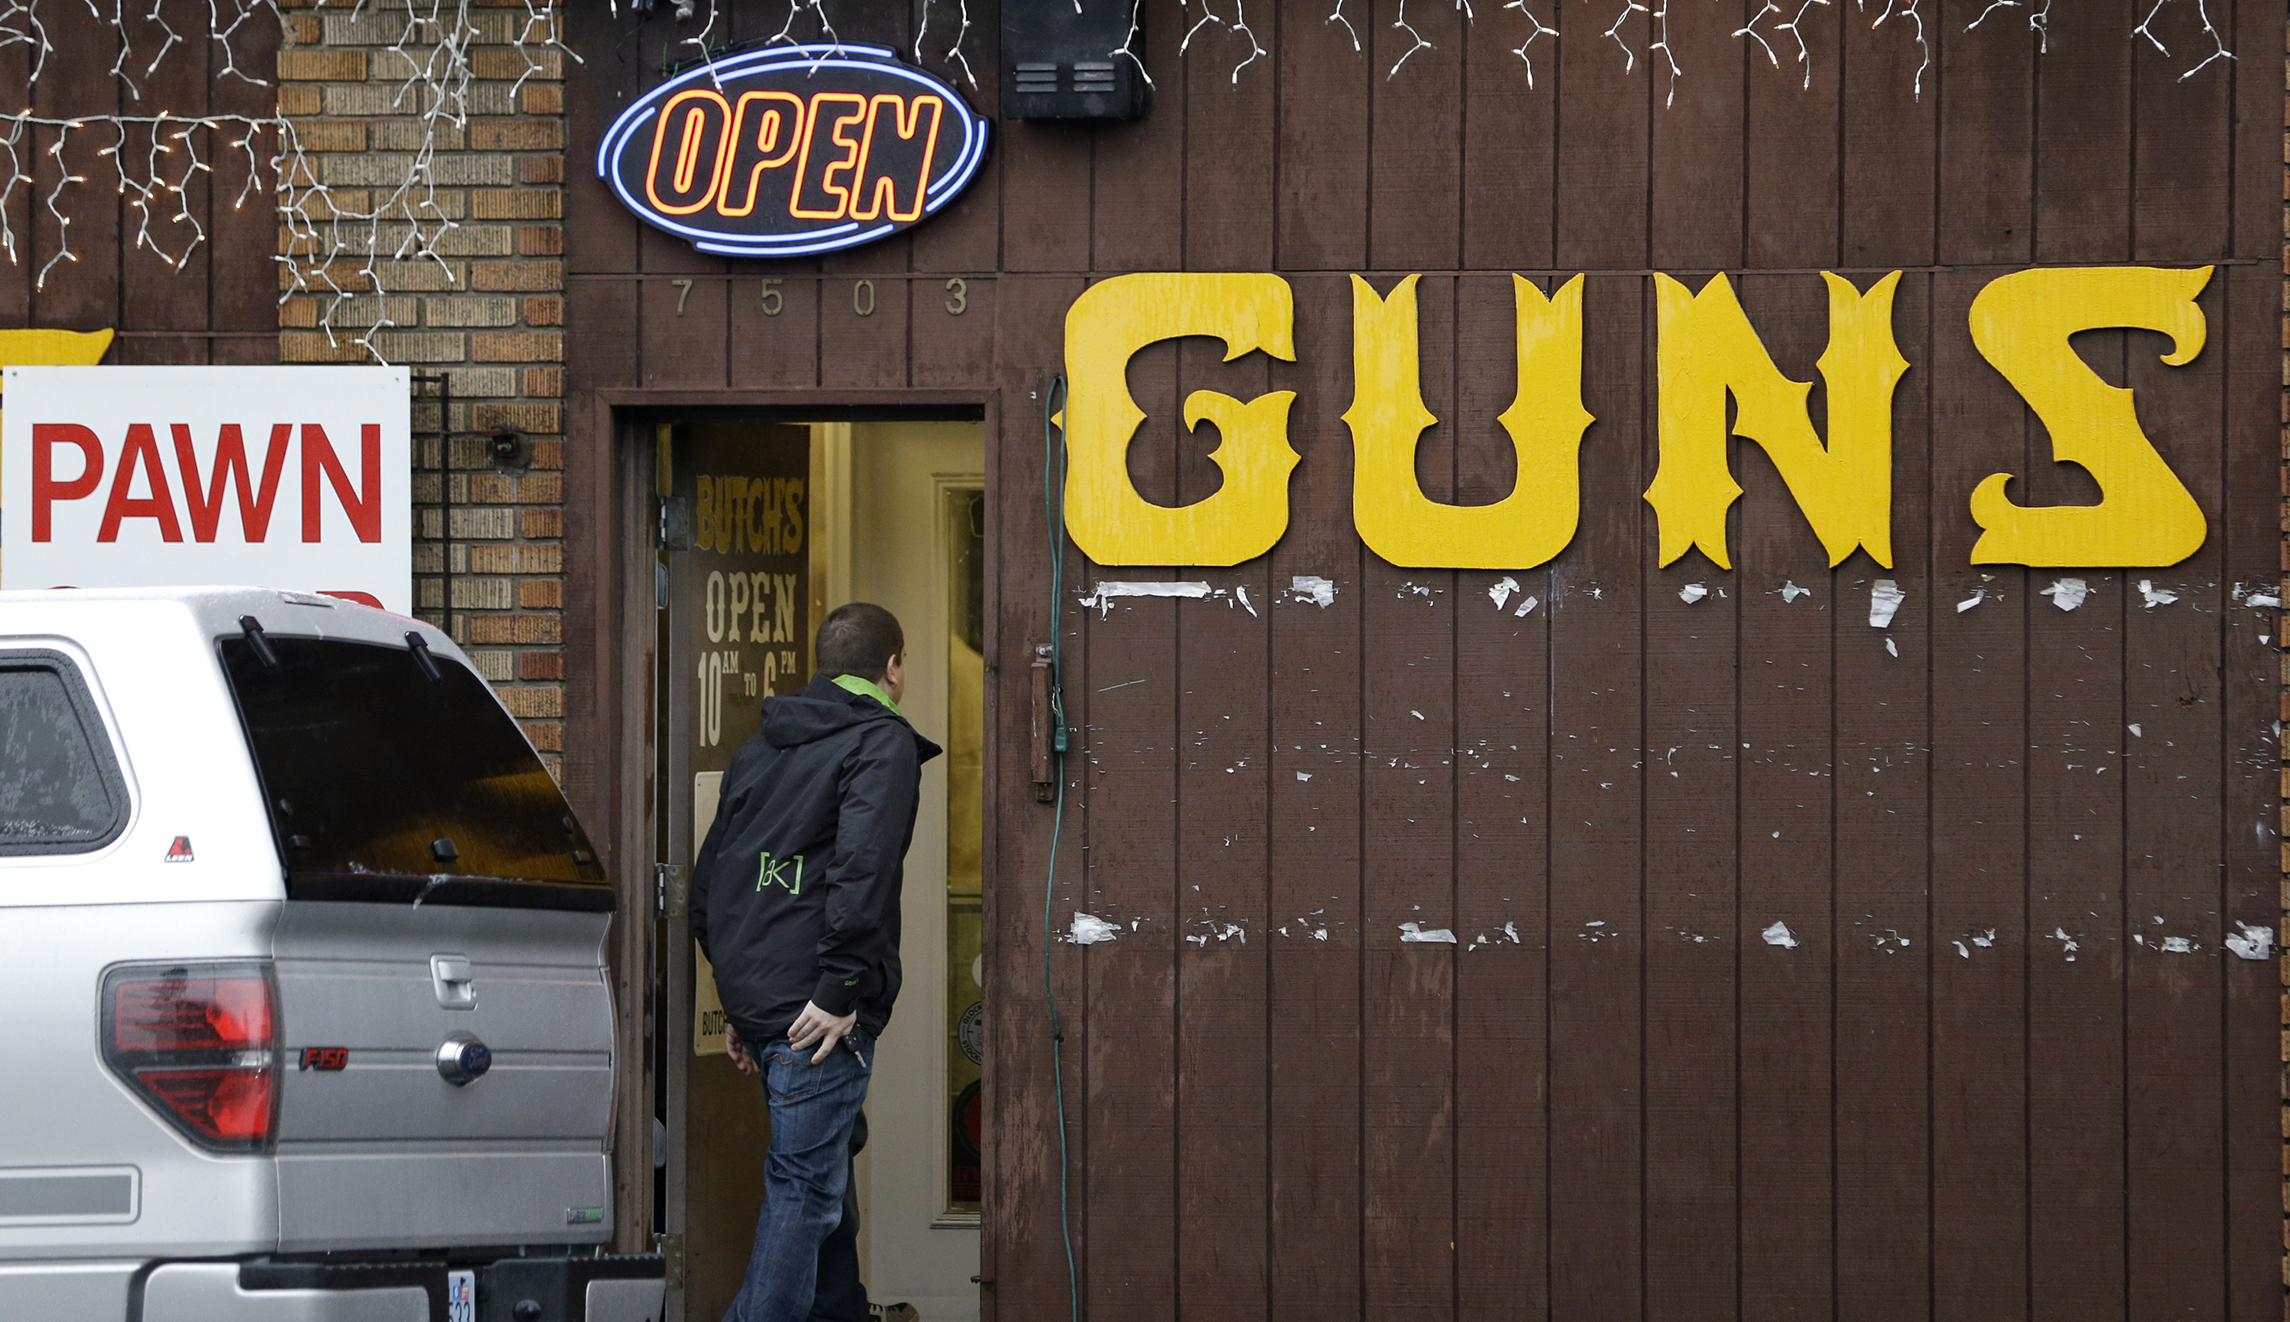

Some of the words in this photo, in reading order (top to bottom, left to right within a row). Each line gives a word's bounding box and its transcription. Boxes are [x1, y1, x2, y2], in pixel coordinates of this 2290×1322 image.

[645, 89, 944, 221] OPEN
[1051, 266, 2214, 570] GUNS
[32, 423, 382, 543] PAWN
[705, 570, 797, 643] OPEN
[698, 651, 721, 747] 10
[722, 650, 739, 674] AM
[743, 672, 757, 697] TO
[780, 650, 797, 674] PM
